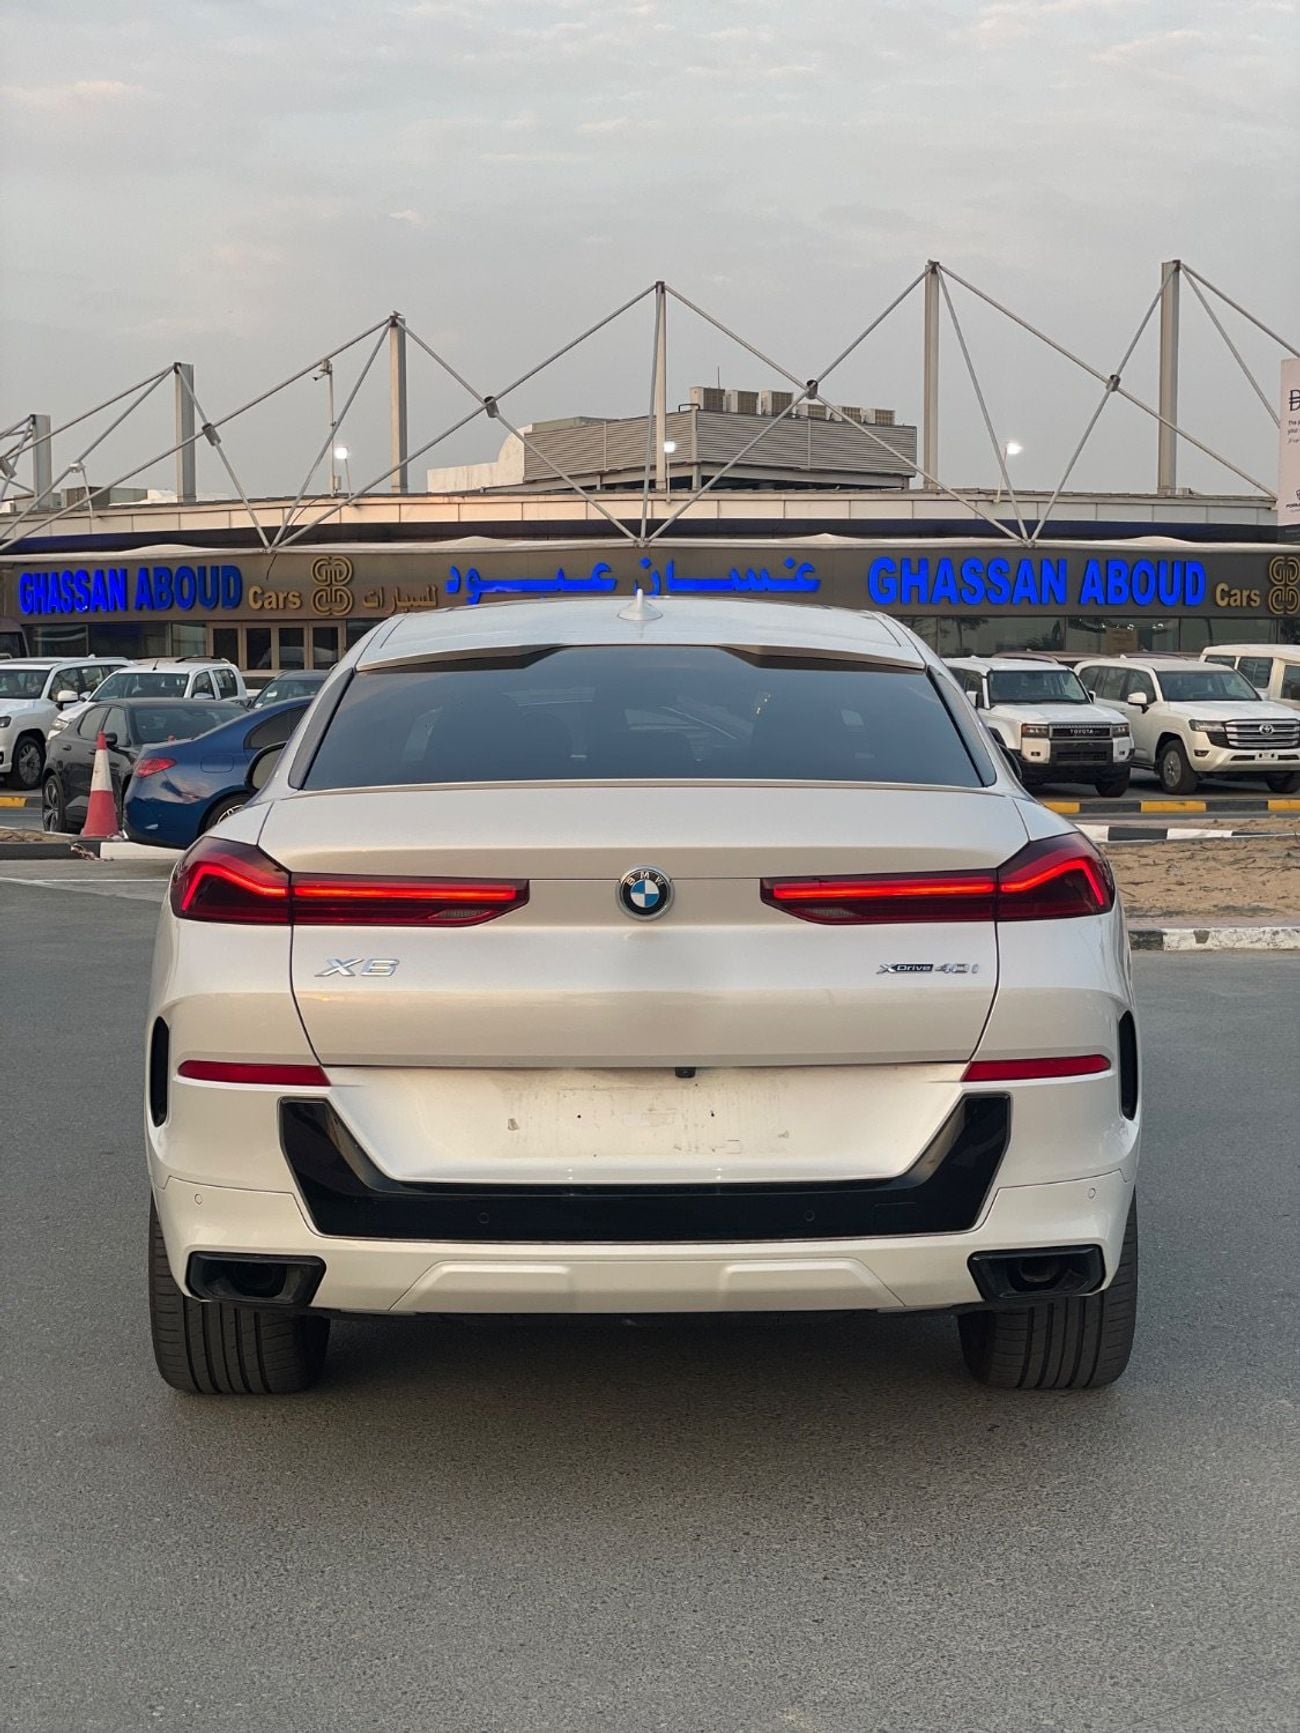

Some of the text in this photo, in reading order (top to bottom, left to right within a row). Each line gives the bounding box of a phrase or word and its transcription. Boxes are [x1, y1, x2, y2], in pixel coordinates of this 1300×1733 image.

[18, 565, 302, 615] GHASSAN ABOUD Cars
[867, 556, 1261, 608] GHASSAN ABOUD Cars
[625, 871, 665, 886] BMW
[314, 957, 400, 977] X6
